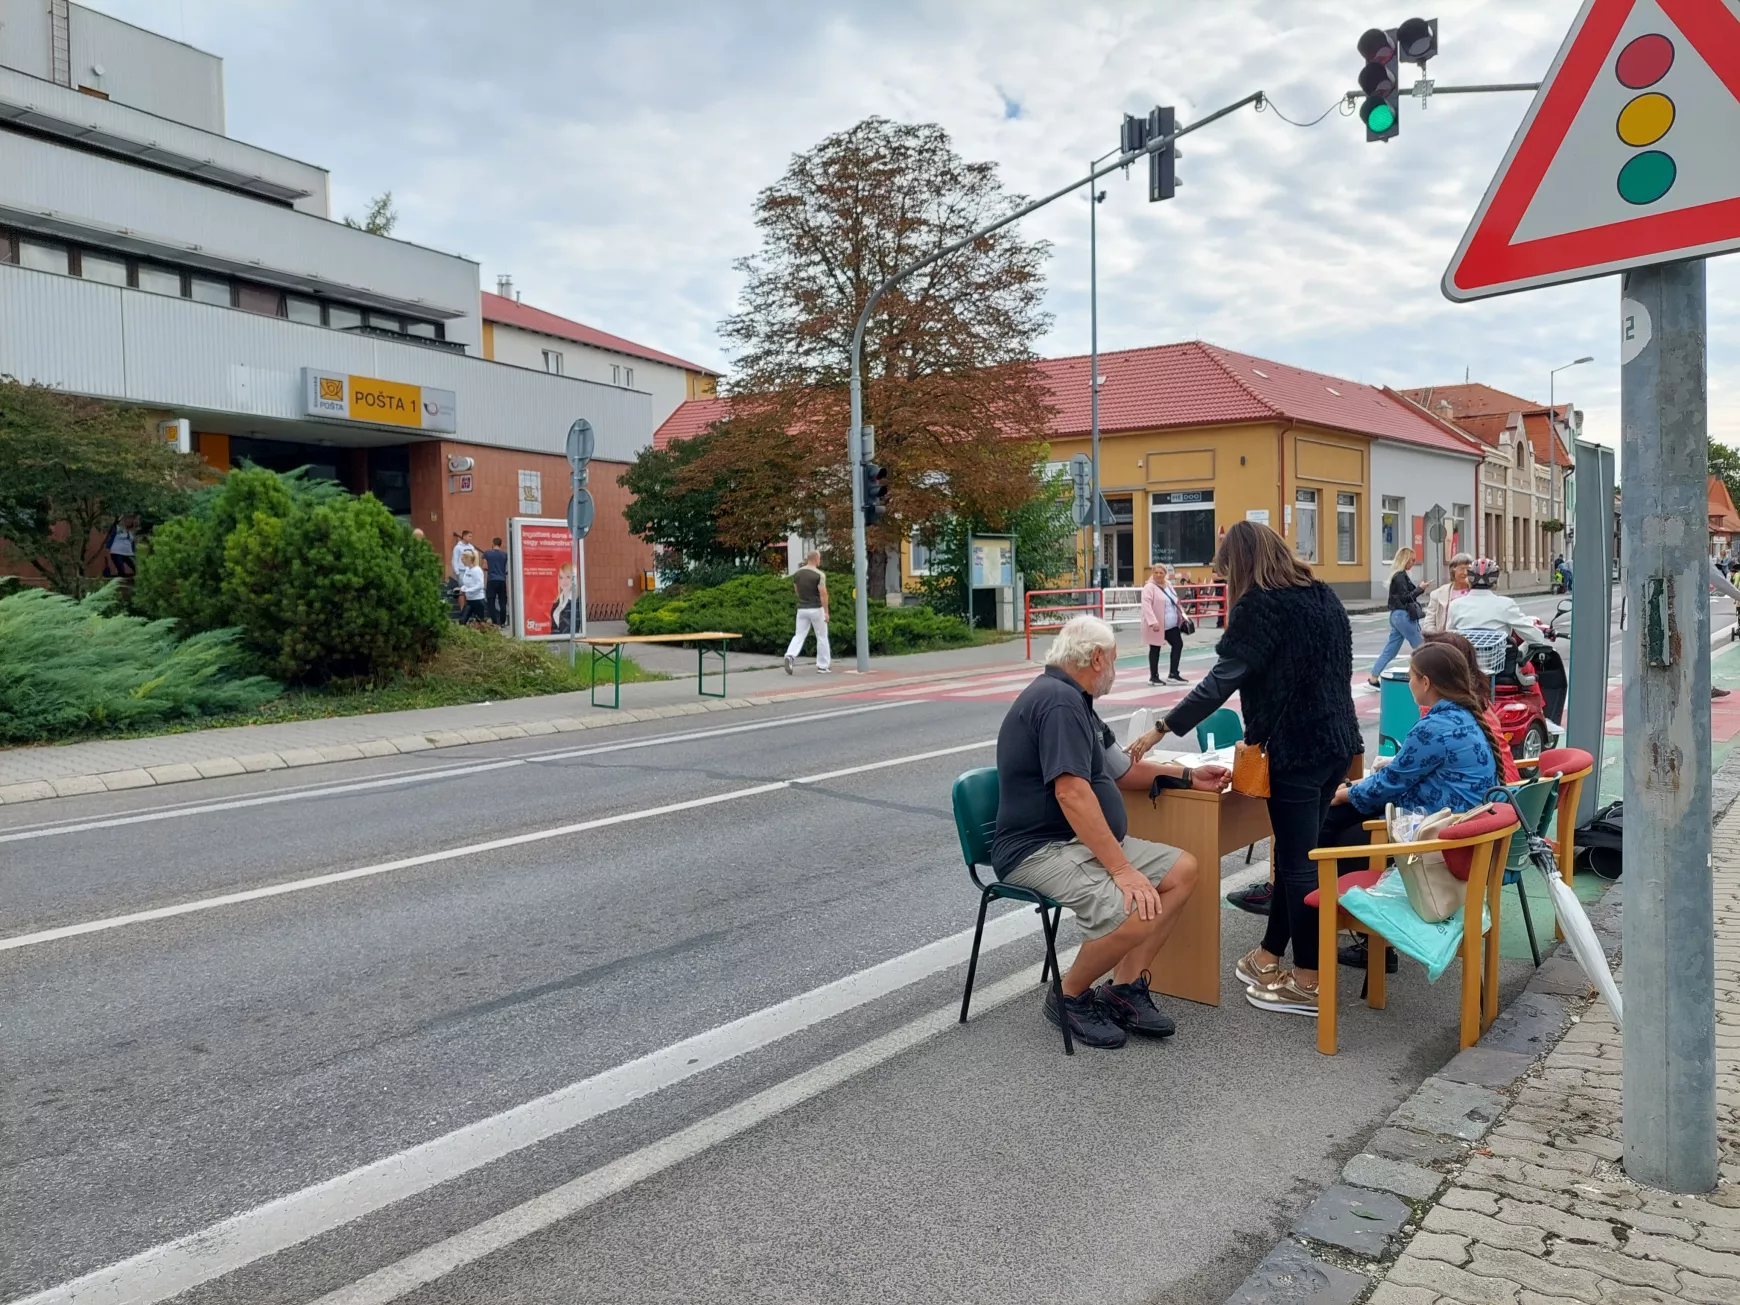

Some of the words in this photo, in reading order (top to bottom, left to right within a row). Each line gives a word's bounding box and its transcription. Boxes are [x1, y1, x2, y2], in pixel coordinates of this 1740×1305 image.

[319, 401, 344, 411] POŠTA
[355, 391, 405, 411] POŠTA
[410, 400, 416, 412] 1
